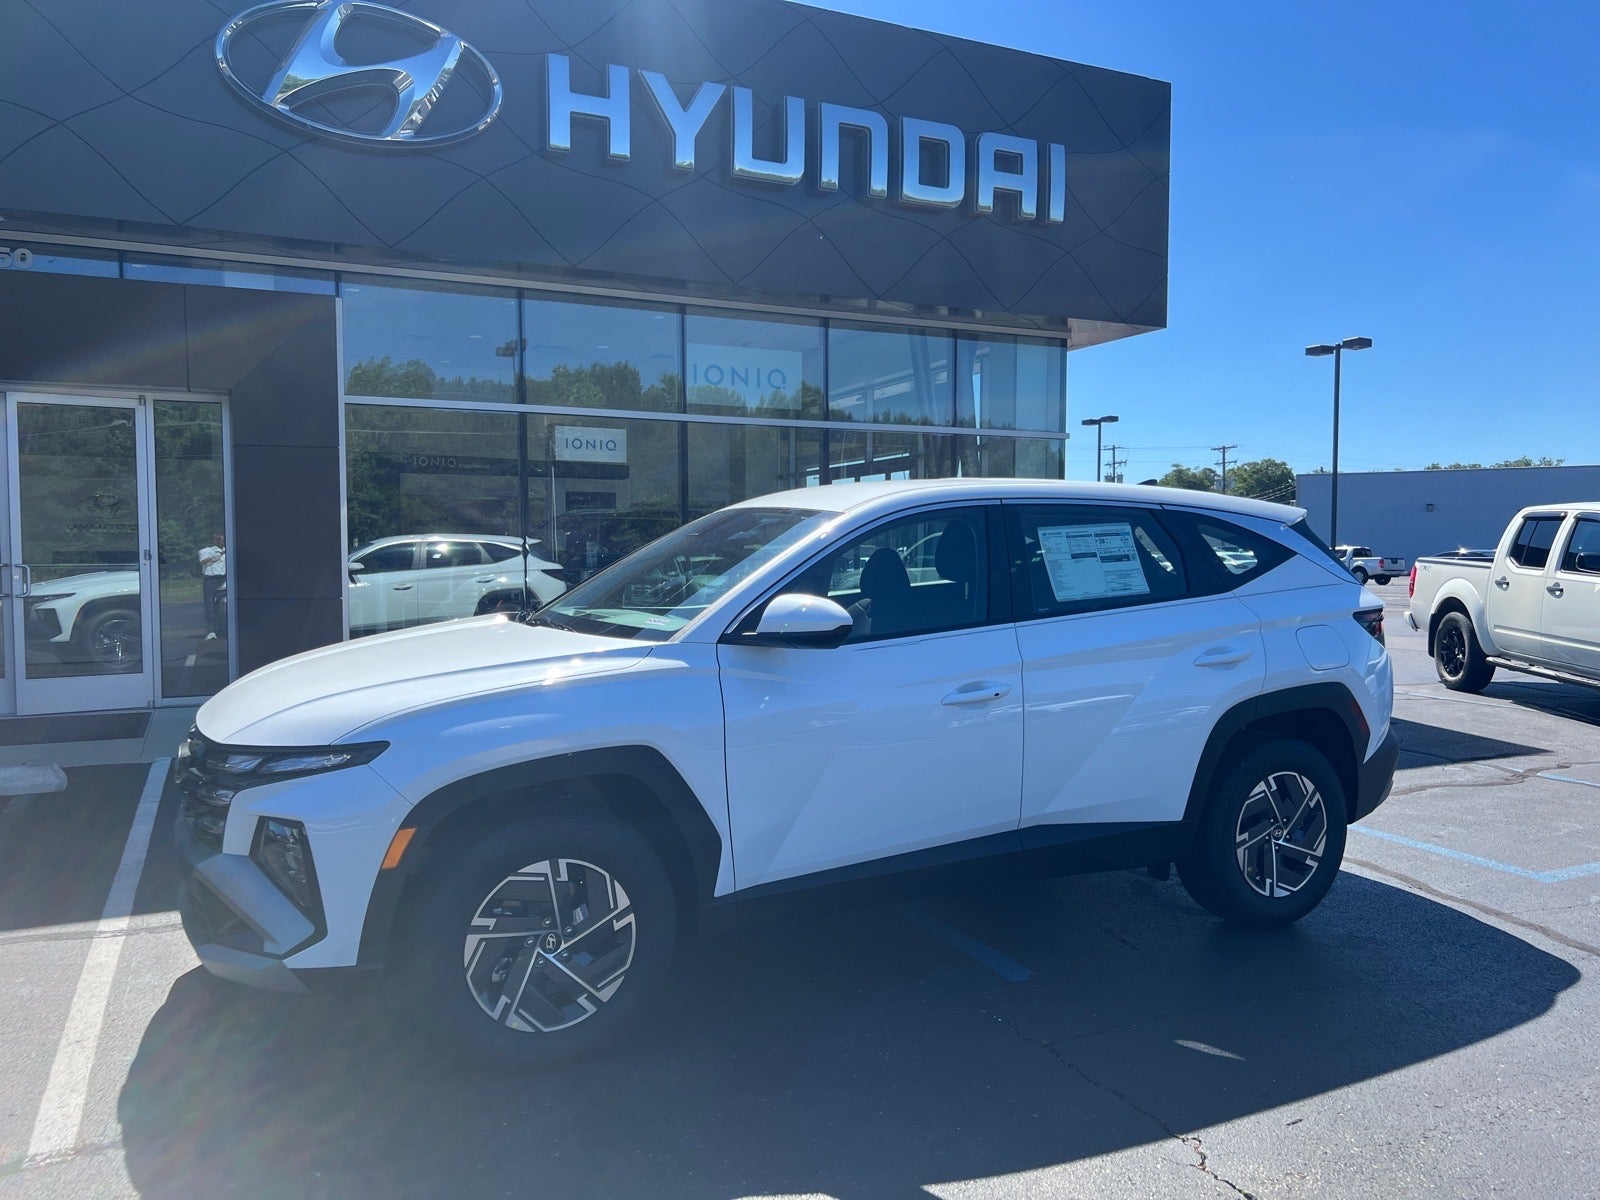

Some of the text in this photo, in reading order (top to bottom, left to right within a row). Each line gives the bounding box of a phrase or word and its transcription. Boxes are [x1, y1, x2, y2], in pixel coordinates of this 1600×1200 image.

[546, 53, 1066, 223] HYUNDAI
[692, 363, 787, 390] IONIQ
[565, 437, 617, 452] IONIQ
[413, 456, 456, 468] IONIQ
